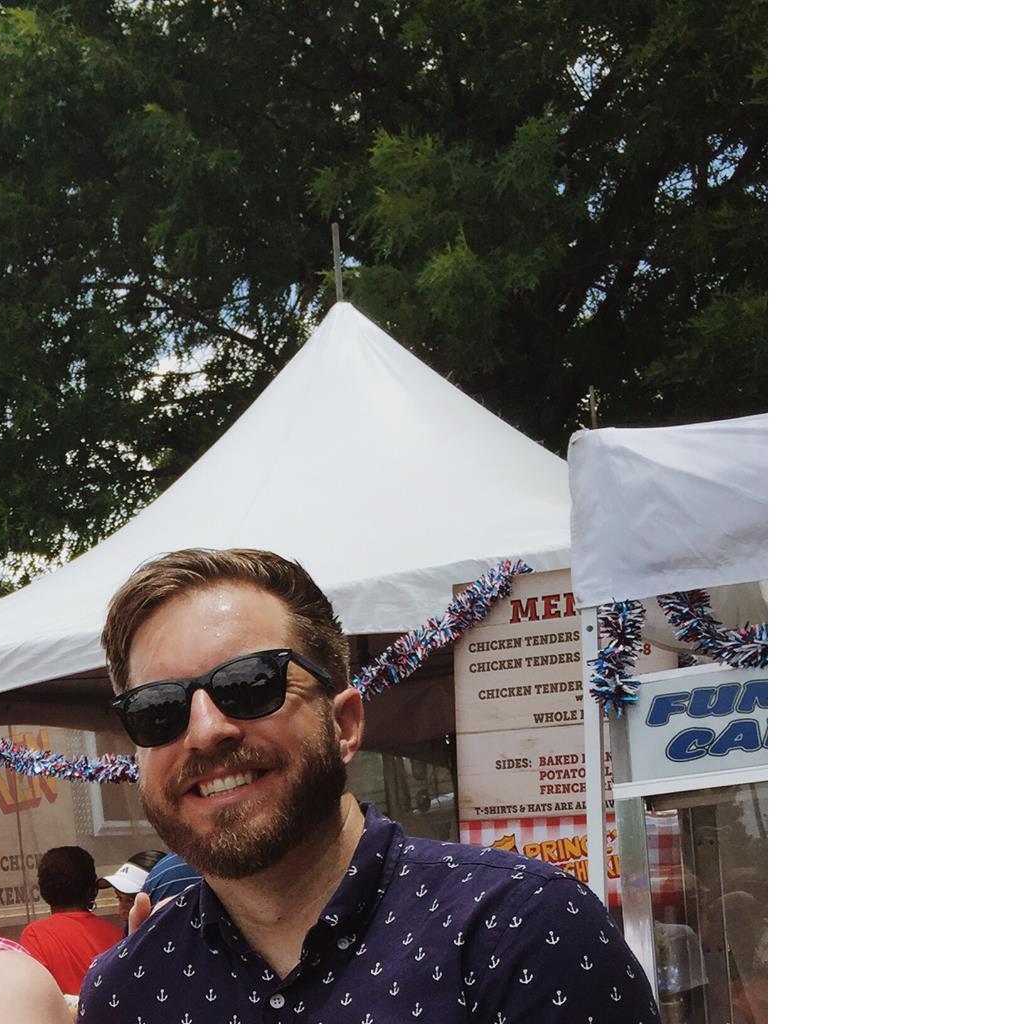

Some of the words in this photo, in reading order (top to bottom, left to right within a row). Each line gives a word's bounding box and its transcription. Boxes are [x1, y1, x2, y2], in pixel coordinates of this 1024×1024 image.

[469, 637, 522, 653] CHICKEN
[525, 631, 580, 647] TENDERS
[469, 657, 522, 674] CHICKEN
[525, 652, 581, 667] TENDERS
[478, 685, 532, 701] CHICKEN
[533, 710, 578, 724] WHOLE
[665, 718, 768, 762] CA
[495, 758, 532, 770] SIDES:
[539, 754, 578, 767] BAKED
[539, 768, 586, 781] POTATO
[475, 805, 518, 815] T-SHIRTS
[520, 805, 525, 813] &
[528, 802, 553, 813] HATS
[554, 802, 574, 811] ARE
